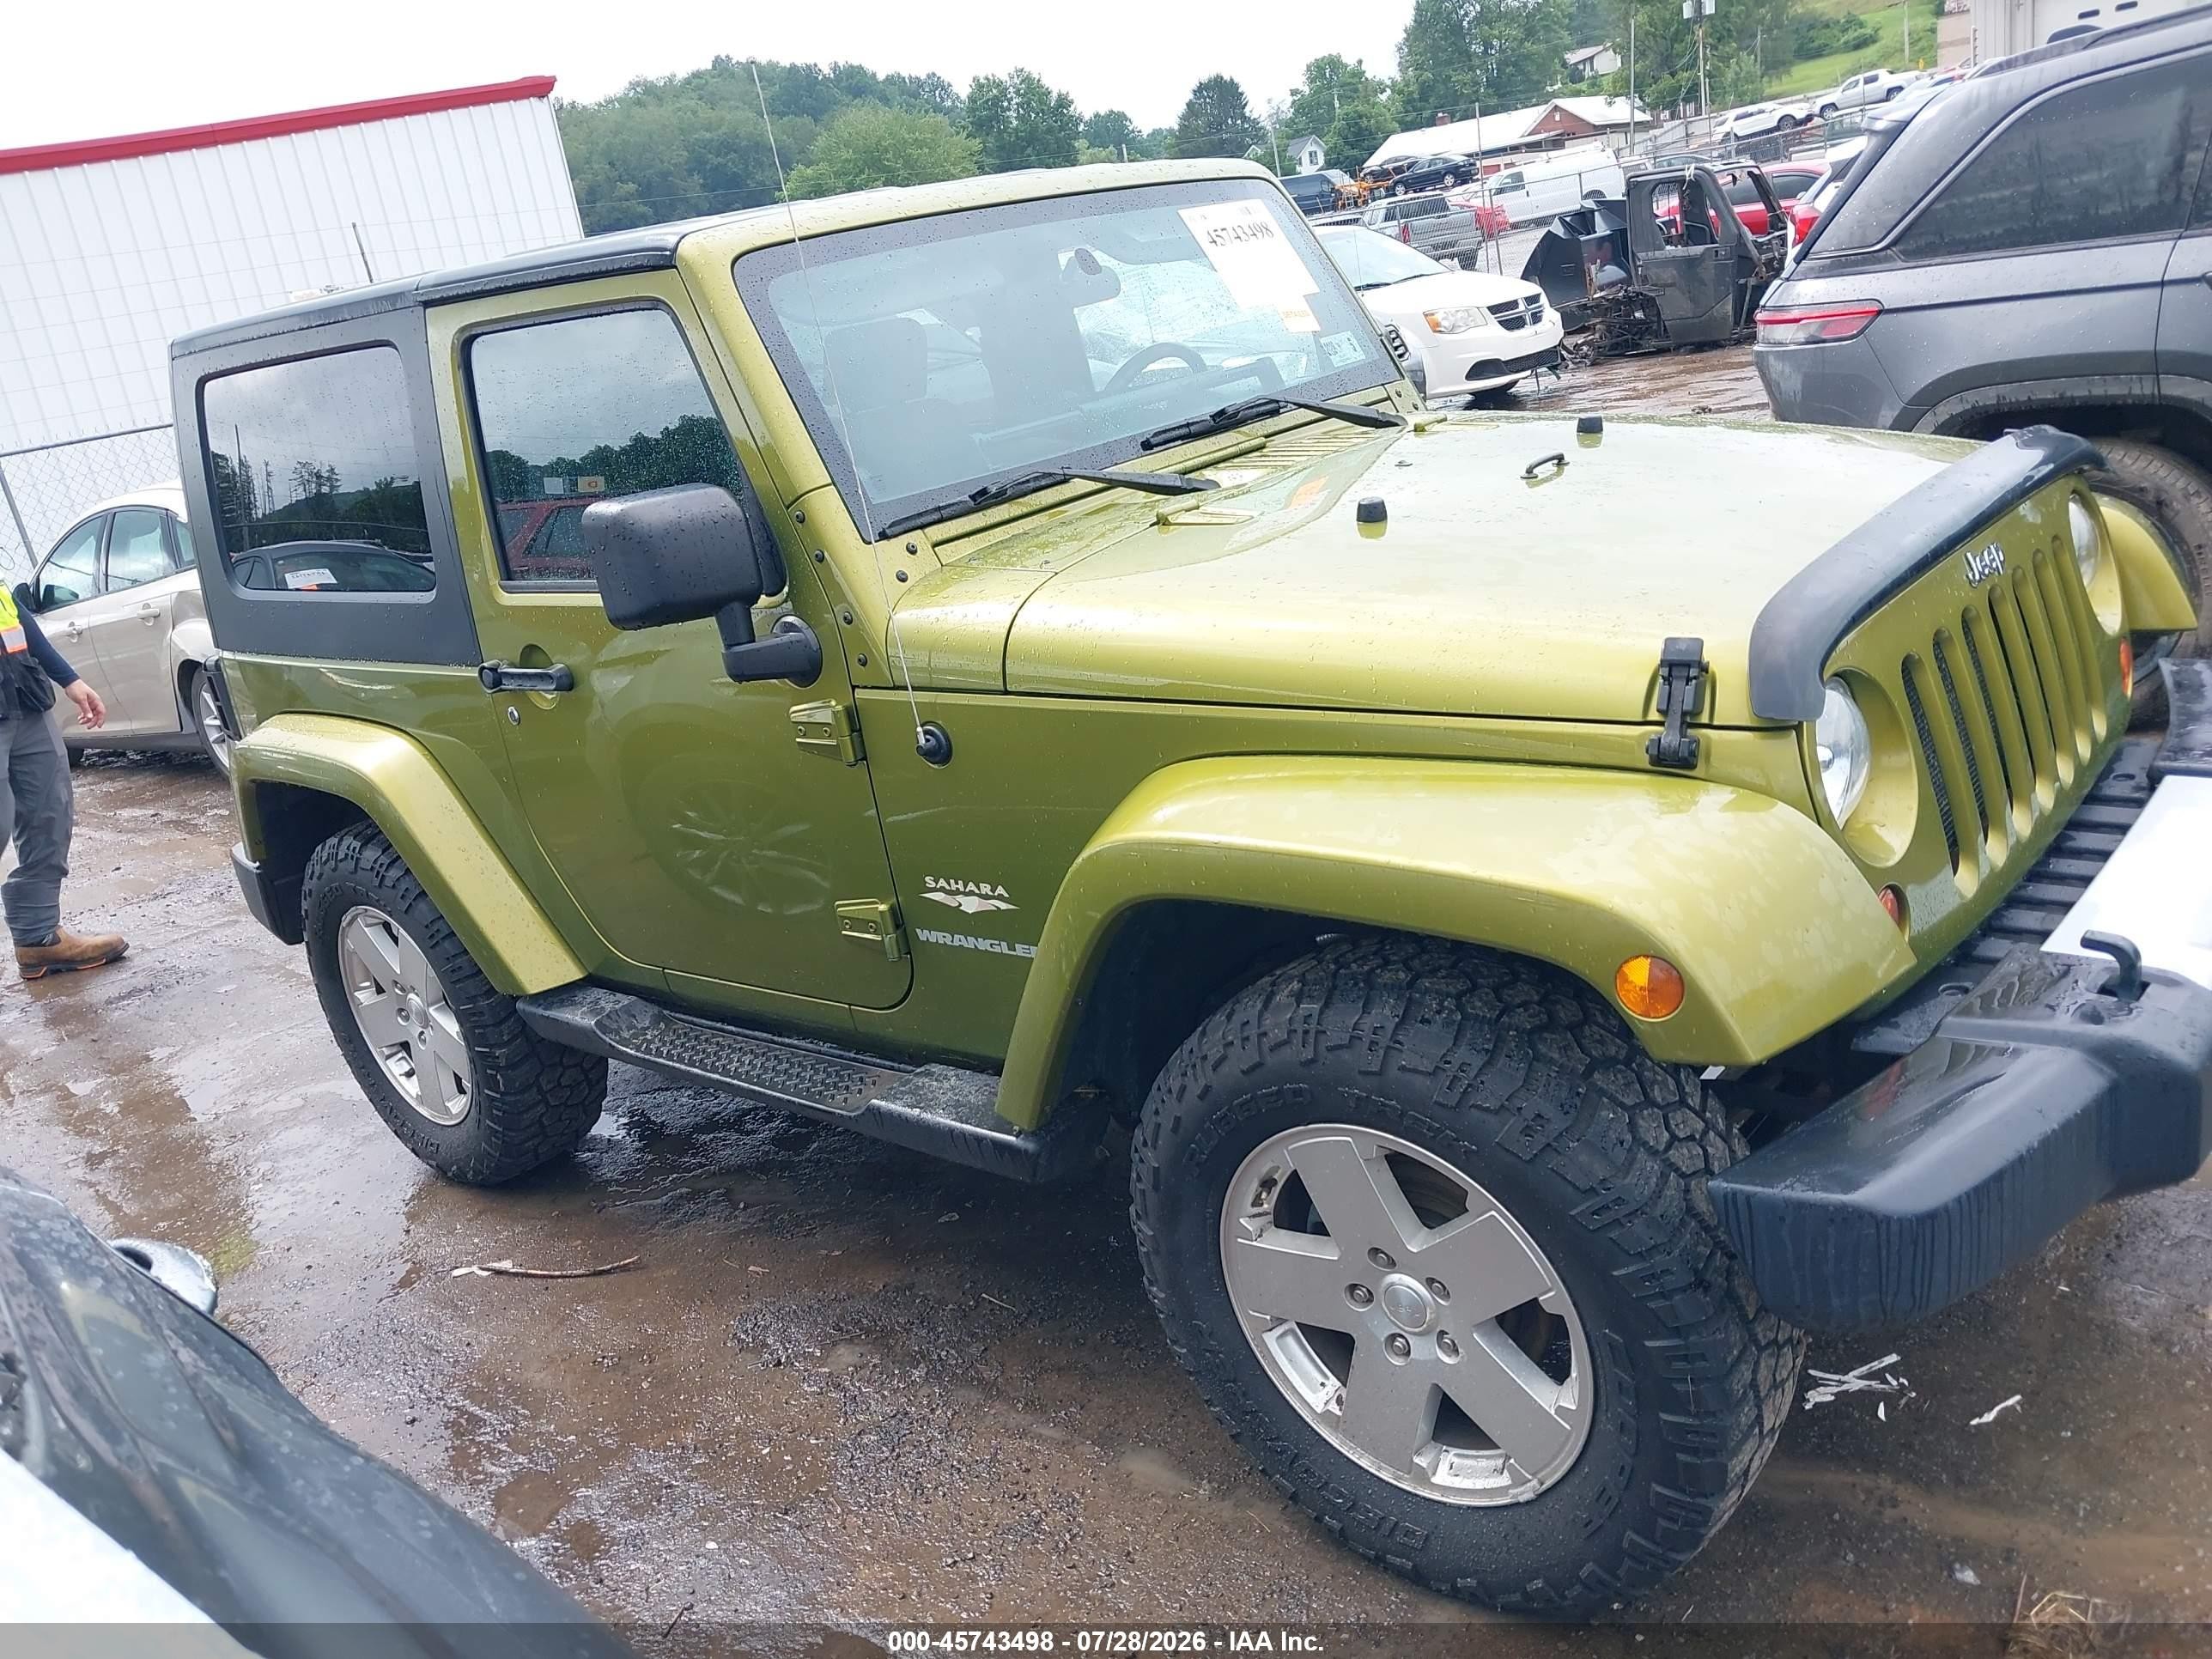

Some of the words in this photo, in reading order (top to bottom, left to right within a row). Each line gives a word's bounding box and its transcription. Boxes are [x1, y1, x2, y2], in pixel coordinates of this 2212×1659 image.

[1206, 221, 1275, 247] 45743498
[1963, 542, 2006, 588] Jeep
[924, 875, 1010, 898] SAHARA
